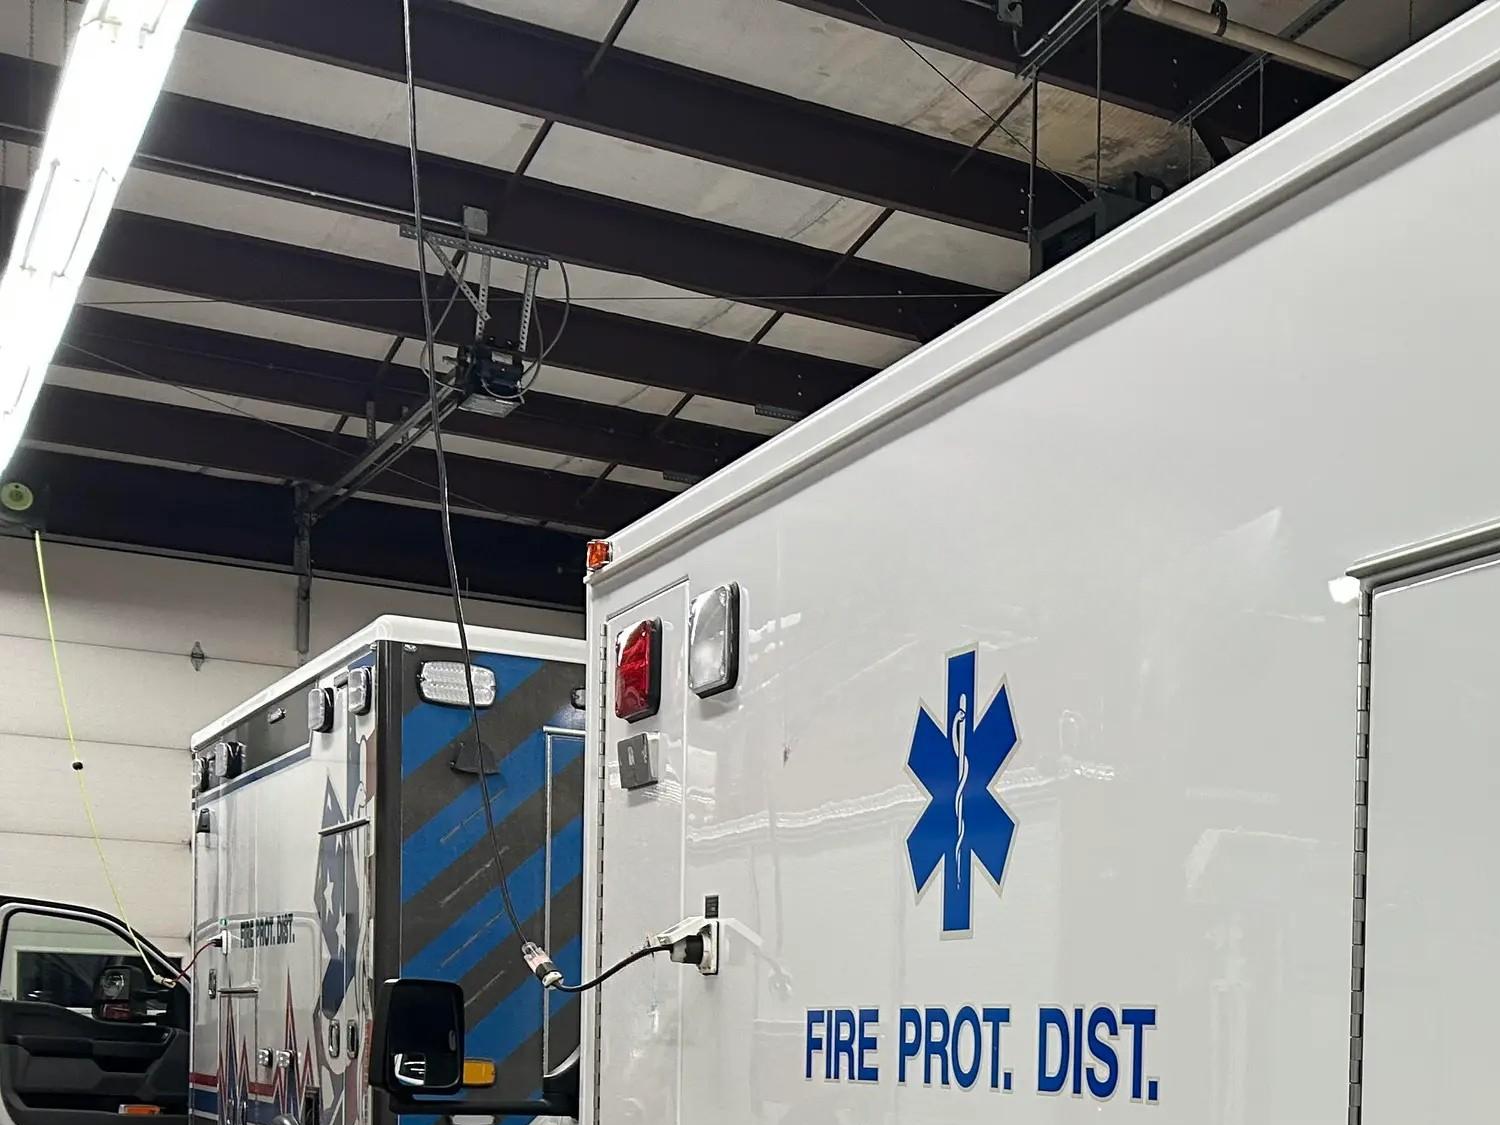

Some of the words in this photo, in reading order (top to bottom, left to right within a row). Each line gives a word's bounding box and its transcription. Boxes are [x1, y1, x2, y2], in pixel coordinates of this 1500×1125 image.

[805, 1007, 879, 1082] FIRE
[897, 1005, 1013, 1093] PROT.
[1036, 1003, 1159, 1104] DIST.
